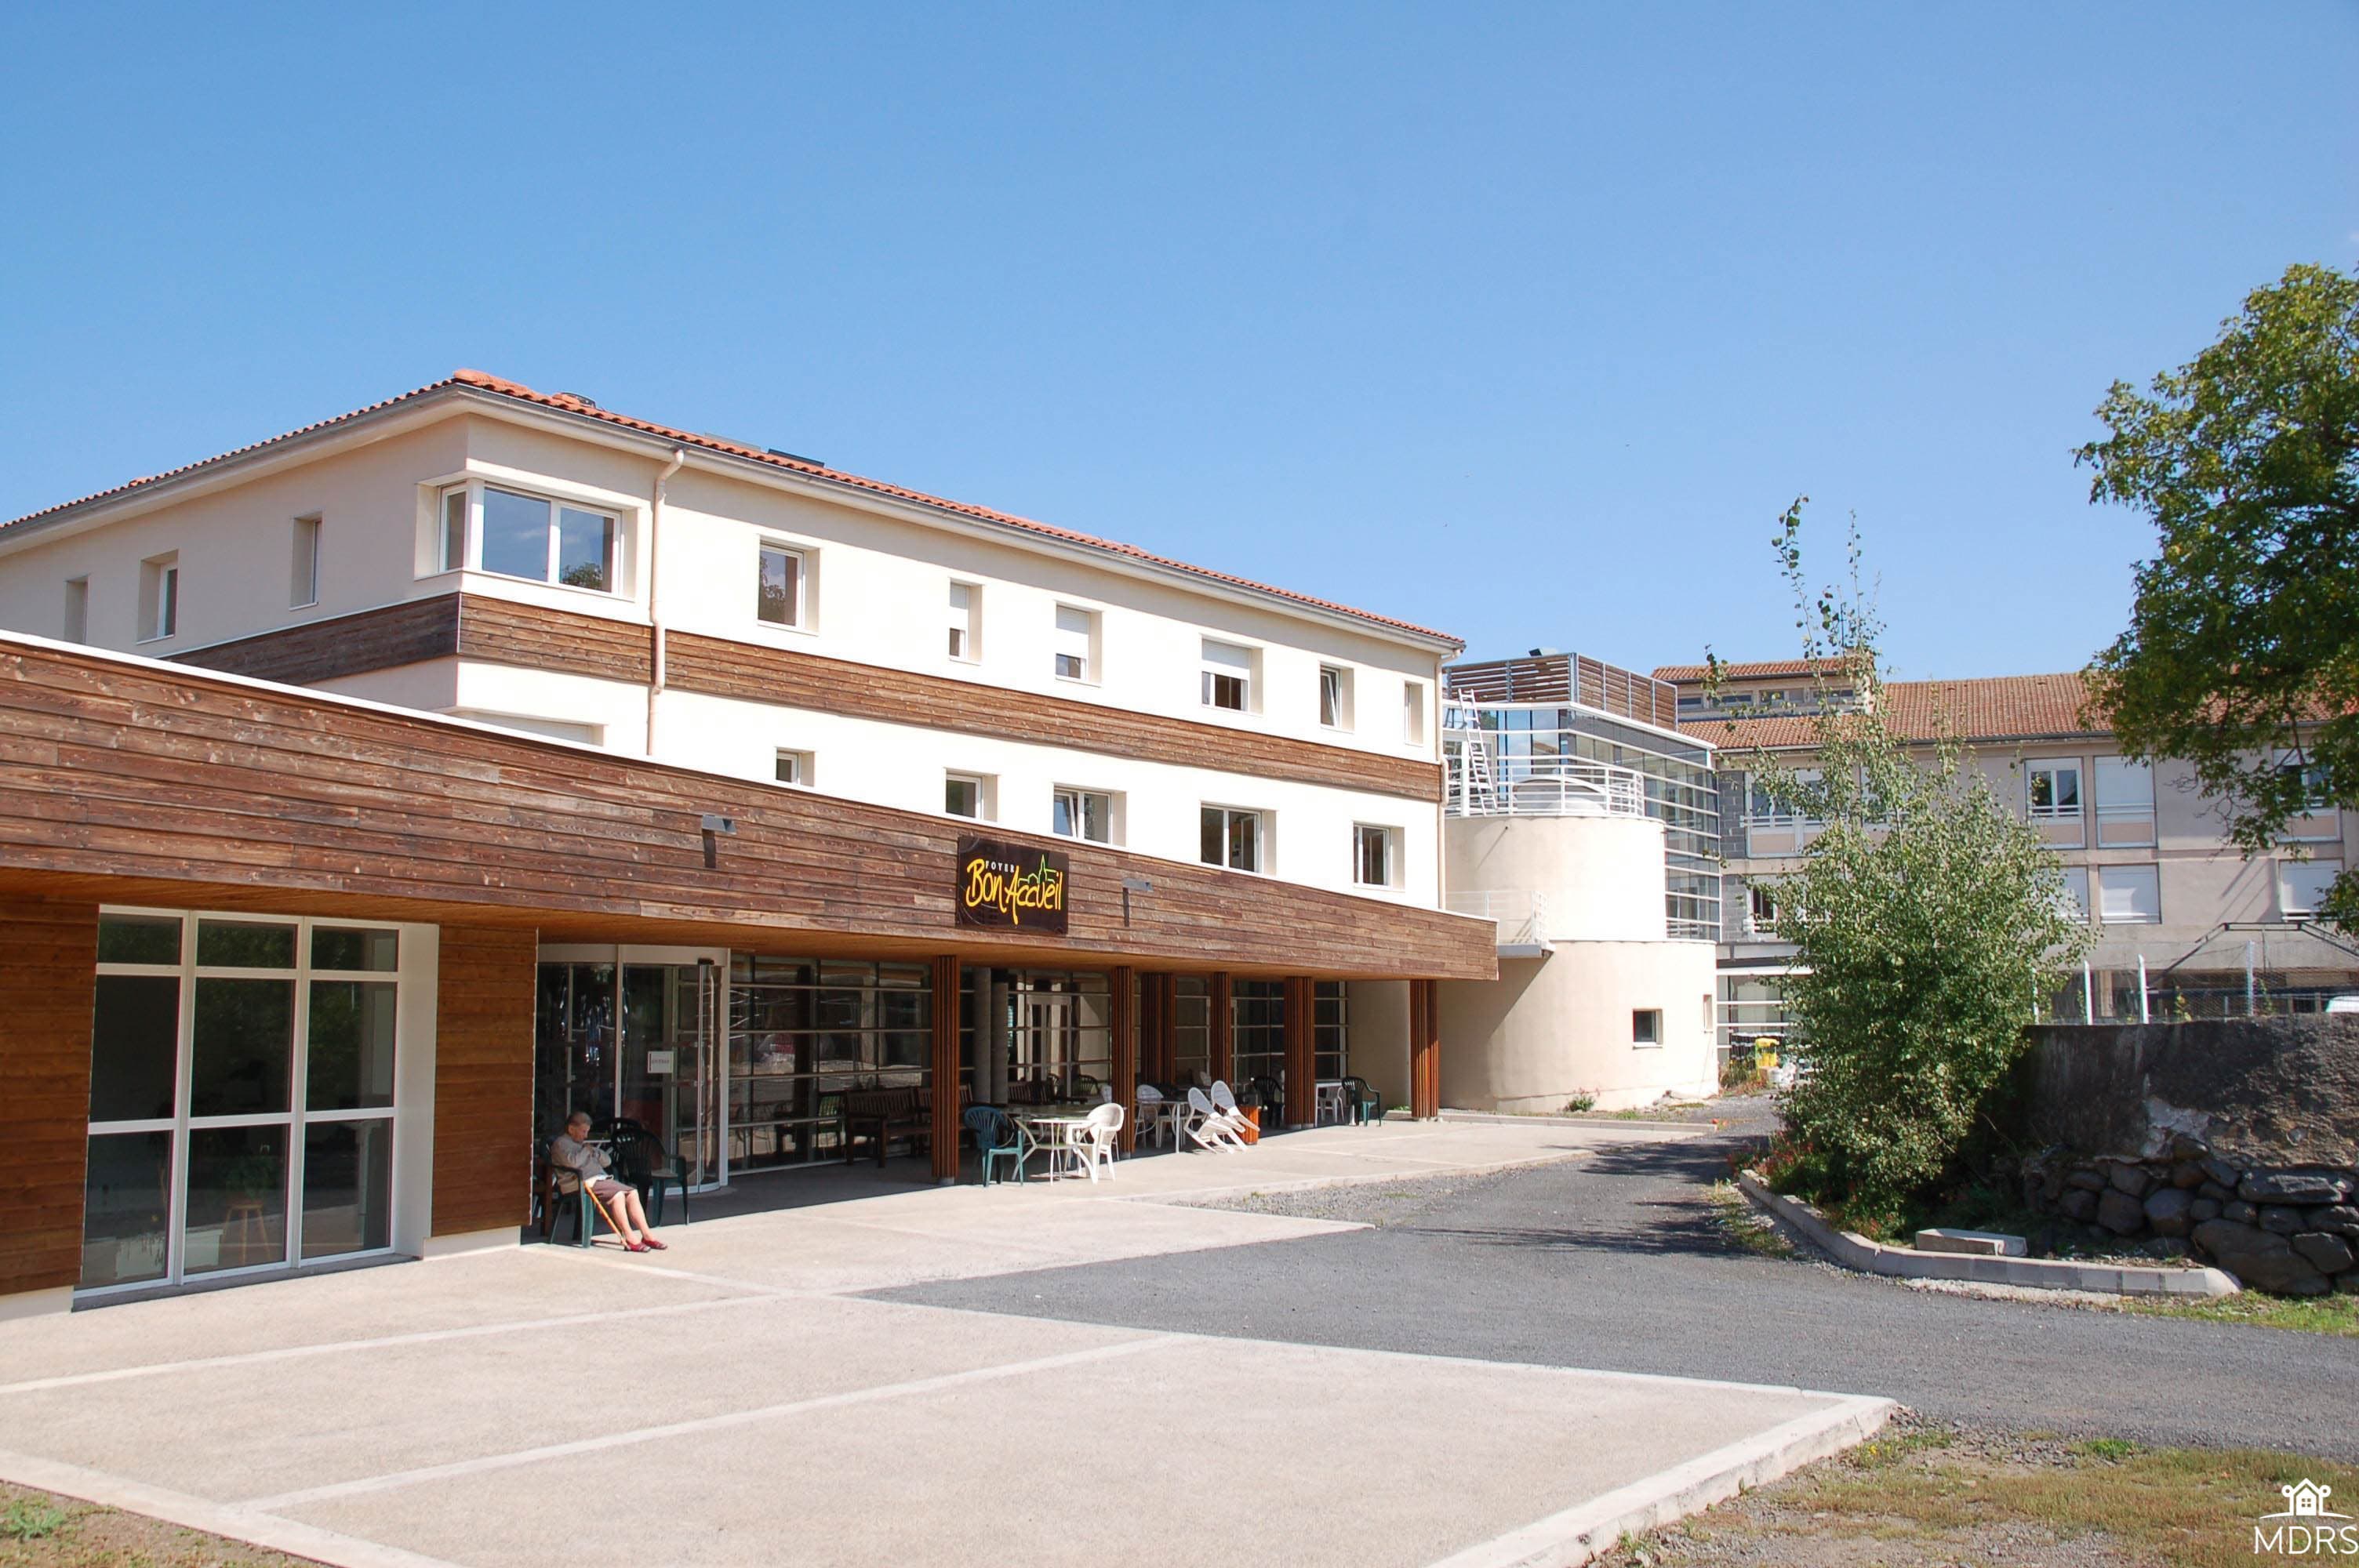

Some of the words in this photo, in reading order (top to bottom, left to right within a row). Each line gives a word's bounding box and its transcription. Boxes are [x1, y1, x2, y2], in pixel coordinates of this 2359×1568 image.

[985, 860, 1015, 873] FOYER
[965, 858, 1008, 913] Bon
[1004, 865, 1063, 925] Accueil
